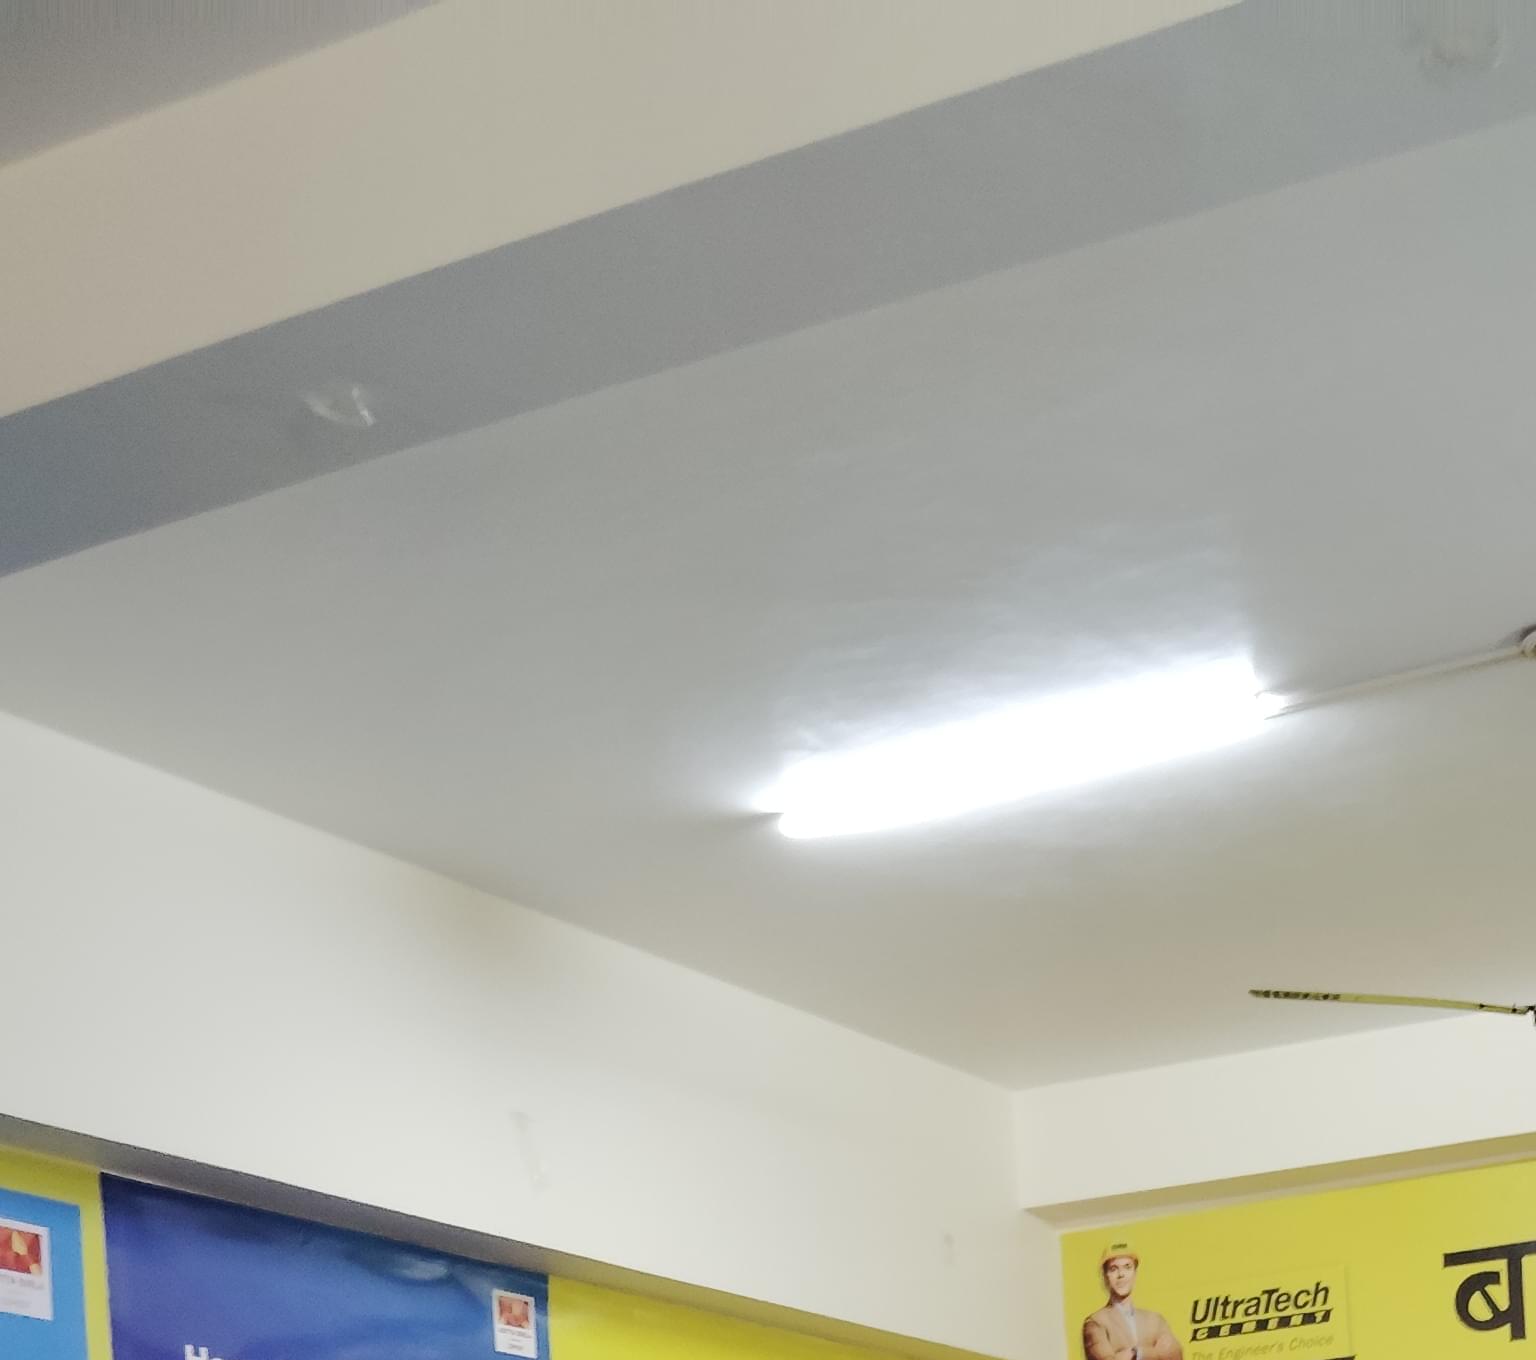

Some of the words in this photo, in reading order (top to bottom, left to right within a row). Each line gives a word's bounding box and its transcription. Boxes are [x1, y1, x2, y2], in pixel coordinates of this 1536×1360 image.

[1189, 1280, 1331, 1326] UltraTech
[1191, 1309, 1333, 1342] CEMENT
[1288, 1333, 1335, 1352] Choice
